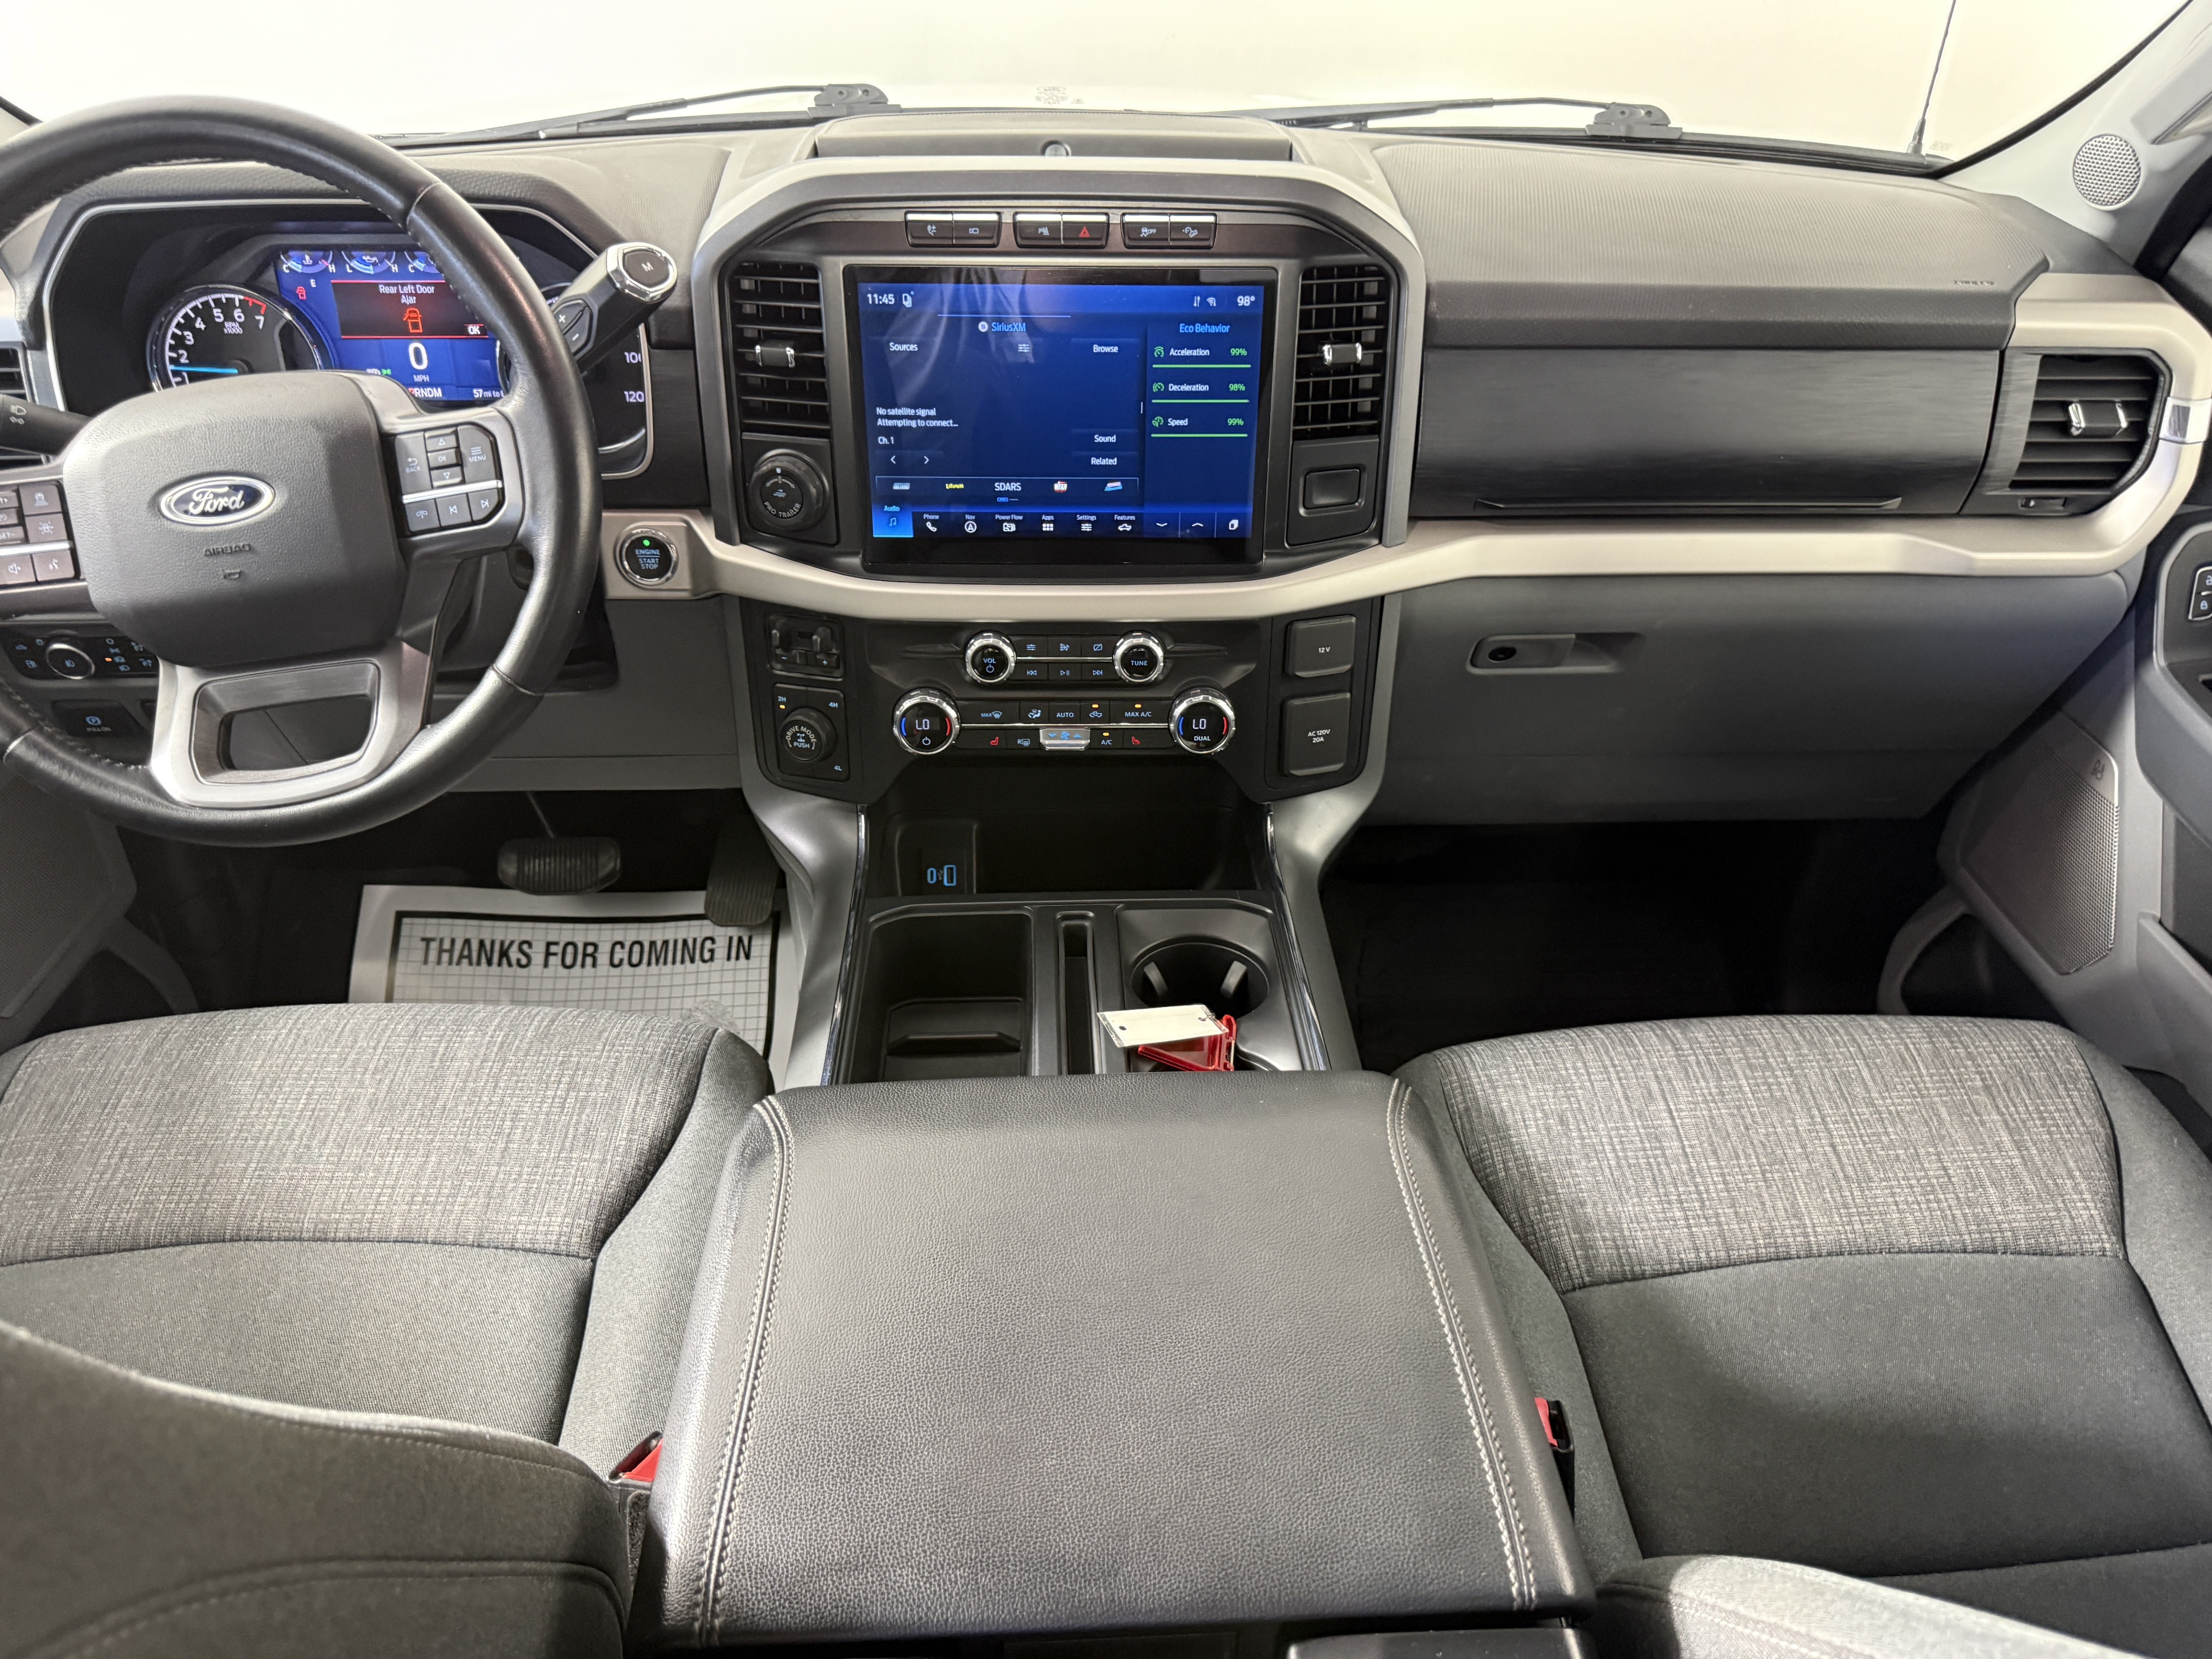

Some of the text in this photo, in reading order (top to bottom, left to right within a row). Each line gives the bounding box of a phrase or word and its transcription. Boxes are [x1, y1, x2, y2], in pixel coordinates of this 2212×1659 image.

[283, 264, 290, 273] C
[328, 264, 336, 273] H
[392, 264, 398, 273] H
[409, 264, 415, 273] C
[643, 262, 653, 271] M
[310, 279, 317, 287] E
[379, 284, 434, 294] Rear Left Door
[867, 294, 895, 304] 11:45
[213, 309, 224, 322] 5
[234, 309, 245, 322] 6
[195, 318, 206, 331] 4
[255, 316, 264, 329] 7
[991, 322, 1026, 332] SiriusXM
[468, 325, 481, 335] OK
[1179, 323, 1230, 333] Eco Behavior
[183, 331, 194, 345] 3
[889, 342, 918, 351] Sources
[1093, 345, 1118, 353] Browse
[178, 350, 189, 363] 2
[409, 342, 428, 369] 0
[1170, 348, 1209, 356] Acceleration
[473, 388, 483, 398] 57
[624, 391, 644, 402] 120
[887, 407, 915, 416] satellite
[915, 408, 936, 417] signal
[877, 418, 917, 428] Attempting
[1168, 418, 1188, 428] Speed
[1091, 457, 1117, 465] Related
[994, 483, 1022, 491] SDARS
[188, 486, 245, 515] Ford
[764, 501, 801, 518] PRO TRAILER
[786, 726, 817, 743] DRIVE MODE
[421, 935, 752, 969] THANKS FOR COMING IN
